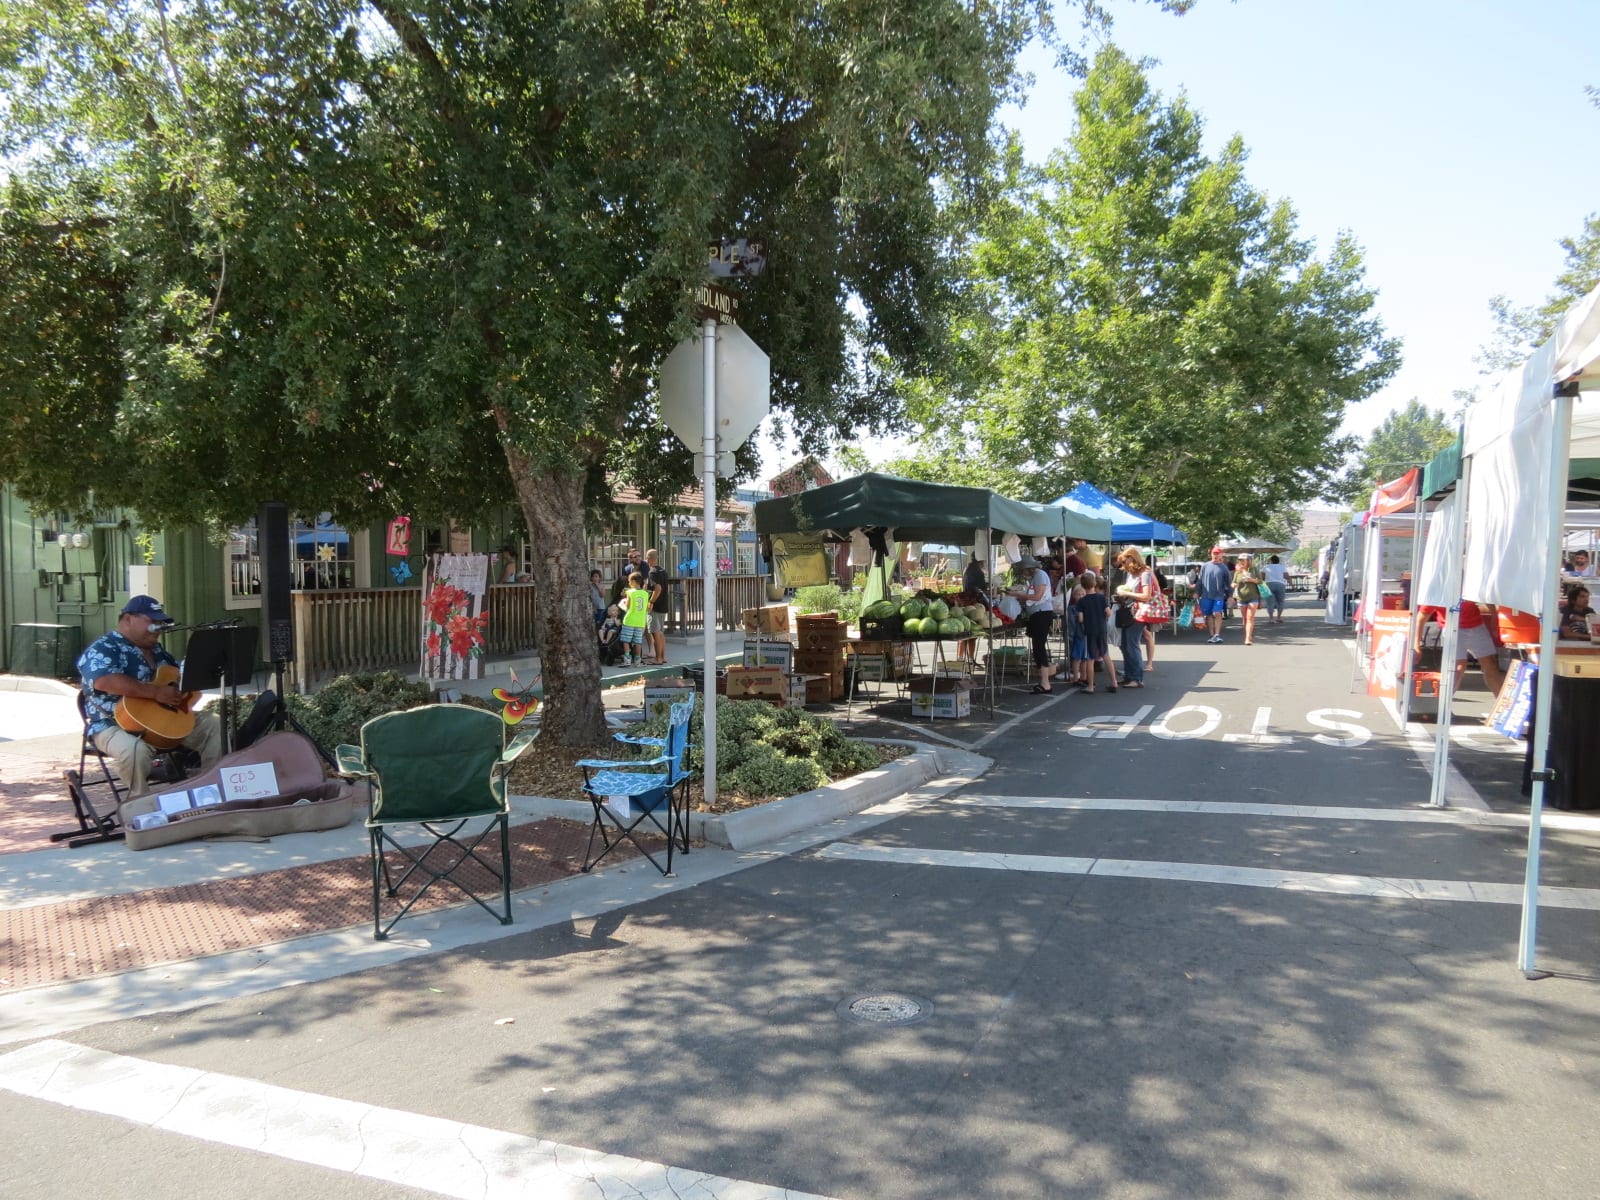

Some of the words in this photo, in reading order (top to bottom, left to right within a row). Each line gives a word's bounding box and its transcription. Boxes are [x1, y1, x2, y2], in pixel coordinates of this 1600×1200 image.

[708, 245, 740, 264] PLE
[750, 243, 760, 254] ST
[636, 596, 644, 612] 3
[1067, 704, 1373, 748] STOP
